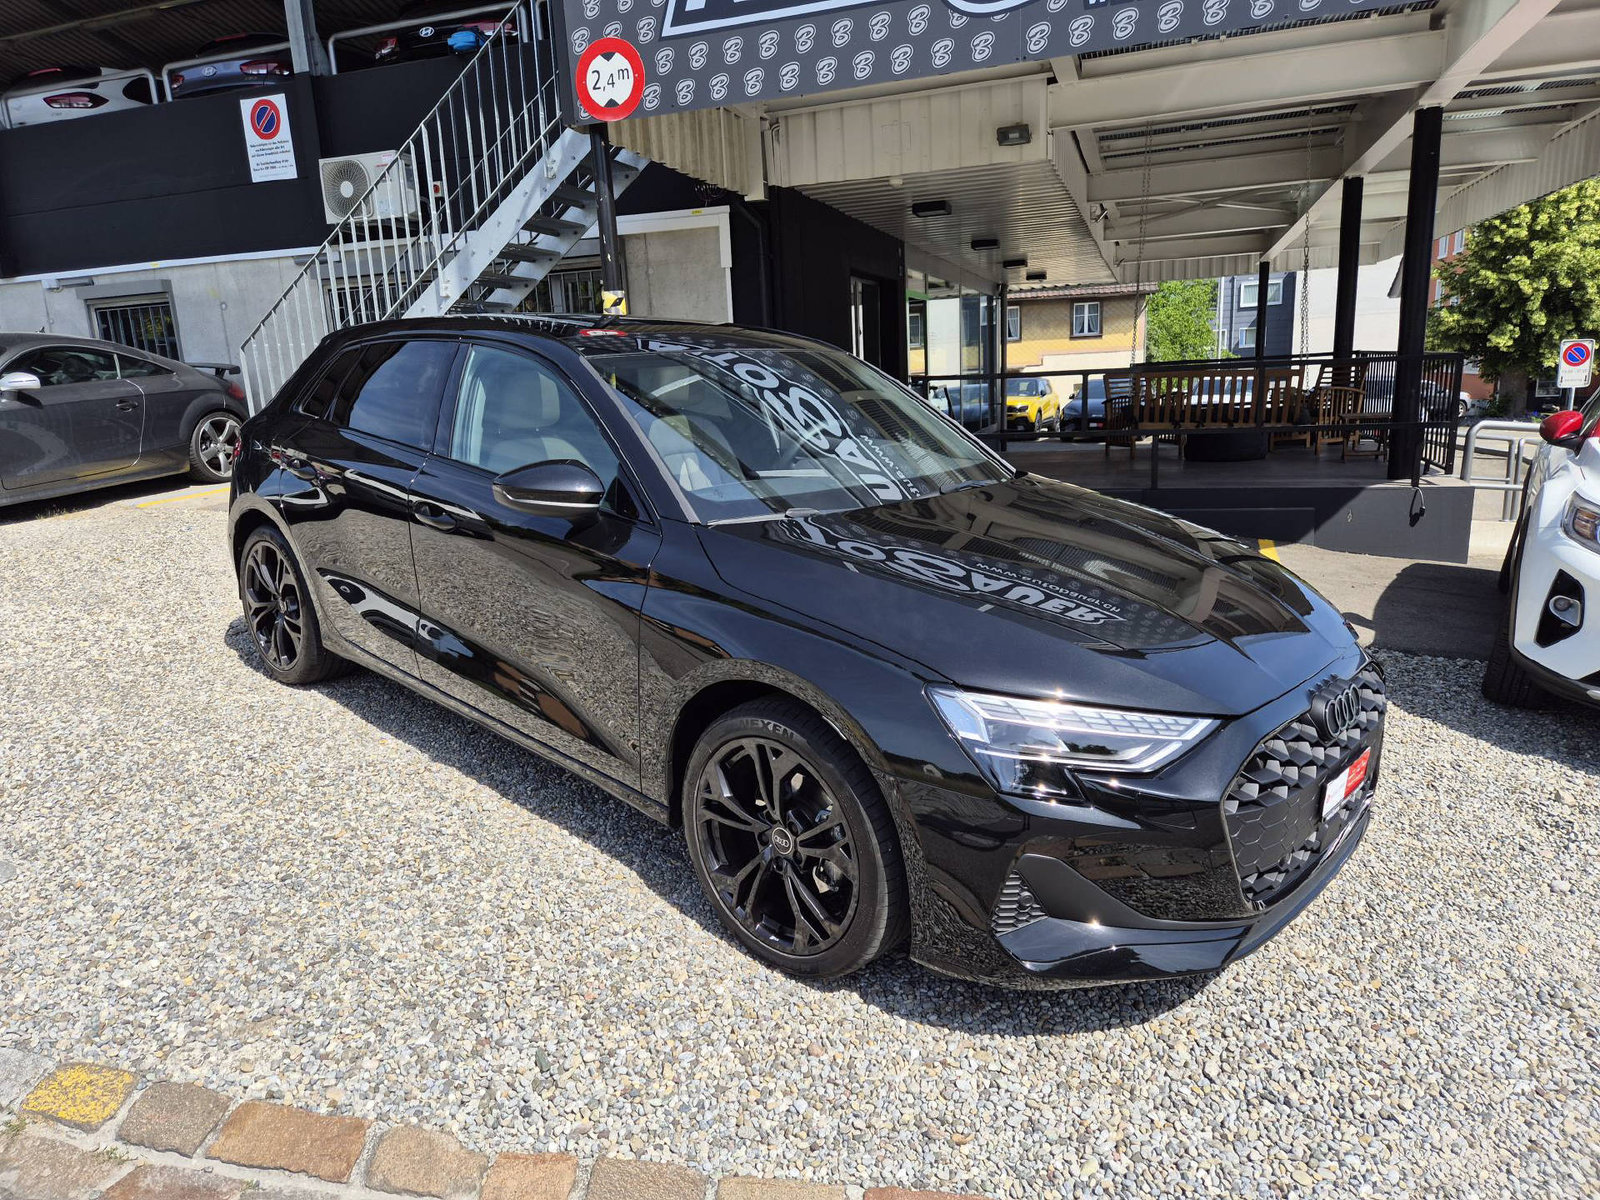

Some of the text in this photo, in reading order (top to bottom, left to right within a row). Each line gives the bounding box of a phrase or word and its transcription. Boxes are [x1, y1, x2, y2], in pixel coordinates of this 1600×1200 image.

[571, 27, 590, 55] B
[637, 16, 656, 44] B
[642, 83, 661, 110] B
[676, 79, 695, 106] B
[709, 73, 729, 100] B
[744, 67, 764, 96] B
[779, 62, 800, 91] B
[816, 57, 837, 85] B
[853, 50, 875, 80] B
[891, 44, 913, 74] B
[931, 38, 954, 68] B
[971, 31, 995, 62] B
[1026, 22, 1051, 54] B
[1069, 15, 1094, 47] B
[1112, 7, 1139, 40] B
[1157, 0, 1184, 33] B
[655, 47, 674, 75] B
[688, 41, 708, 70] B
[723, 36, 743, 64] B
[759, 30, 779, 59] B
[795, 24, 816, 54] B
[831, 18, 853, 47] B
[869, 11, 891, 41] B
[907, 4, 930, 35] B
[740, 719, 797, 740] NEXEN
